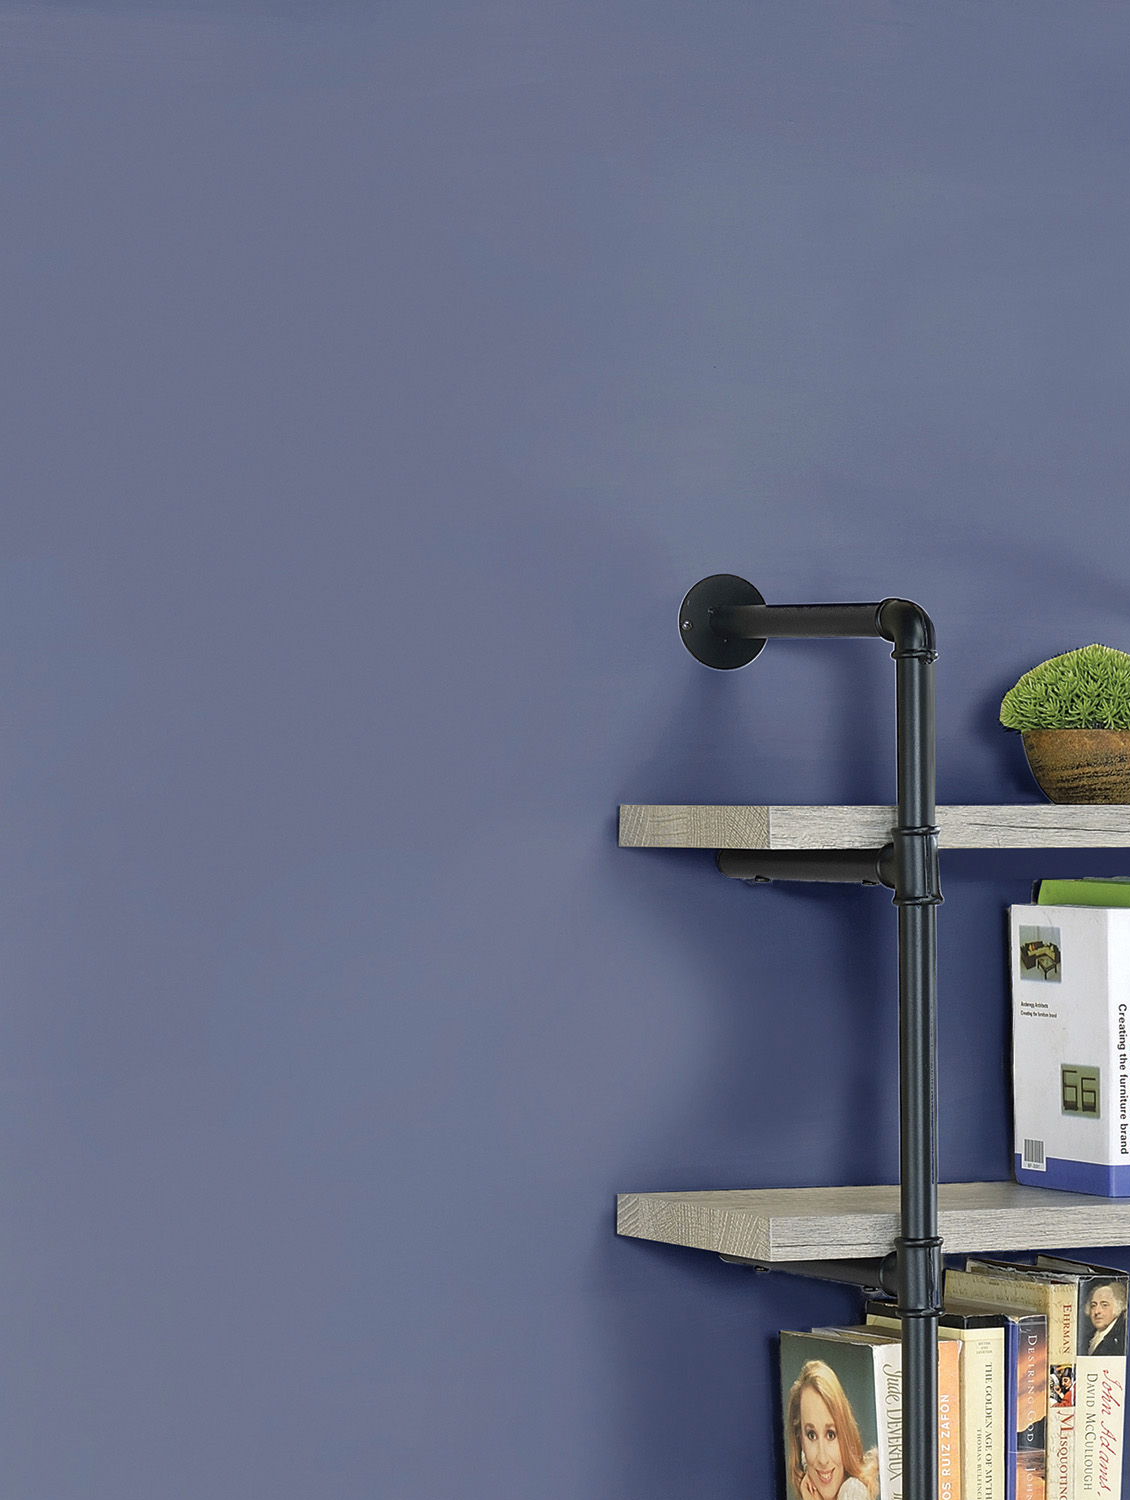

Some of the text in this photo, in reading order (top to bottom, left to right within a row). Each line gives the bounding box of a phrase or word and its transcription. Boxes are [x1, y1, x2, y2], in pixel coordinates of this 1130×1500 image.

[1118, 1004, 1129, 1154] Creating the furniture brand
[1062, 1304, 1073, 1354] EHRMAN
[883, 1364, 902, 1405] Jude
[1026, 1334, 1038, 1442] DESIRING GOD
[1086, 1373, 1098, 1407] DAVID
[1101, 1370, 1123, 1416] John
[938, 1394, 950, 1438] ZAFÓN
[941, 1444, 950, 1476] RUIZ
[985, 1453, 992, 1468] OF
